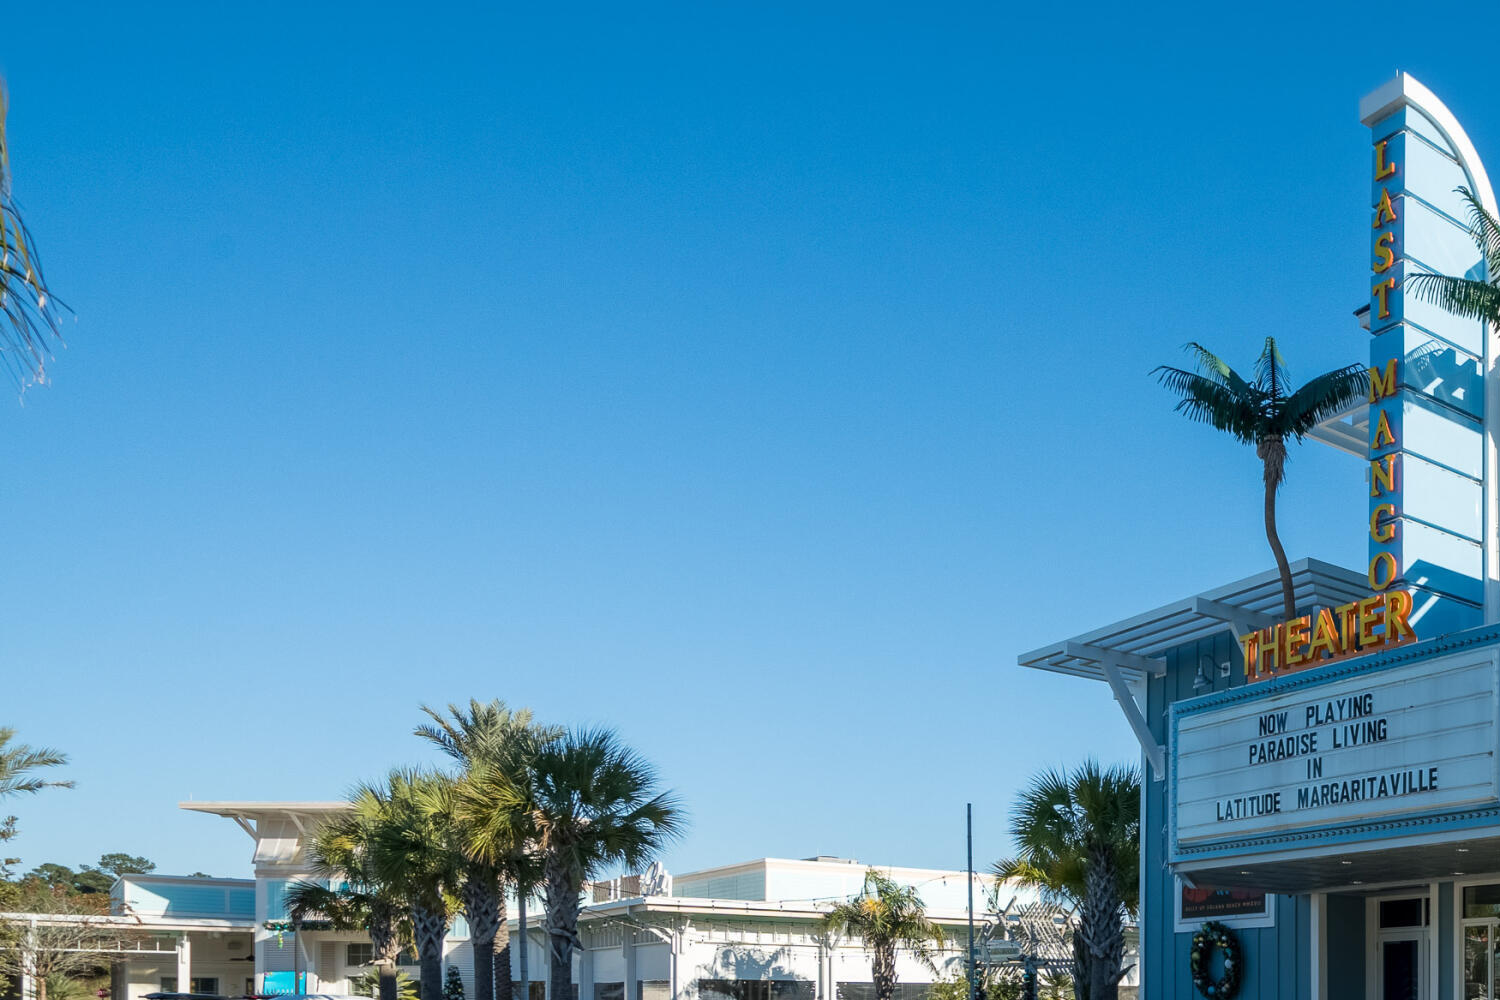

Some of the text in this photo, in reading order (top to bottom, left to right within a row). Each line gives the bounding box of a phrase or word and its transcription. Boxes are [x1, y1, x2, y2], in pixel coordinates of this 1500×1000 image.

[1372, 140, 1396, 321] LAST
[1368, 358, 1398, 592] MANGO
[1240, 589, 1417, 679] THEATER
[1249, 719, 1387, 765] PARADISE LIVING
[1259, 693, 1373, 737] NOW PLAYING
[1216, 768, 1438, 822] LATITUDE MARGARITAVILLE
[1307, 757, 1322, 779] IN
